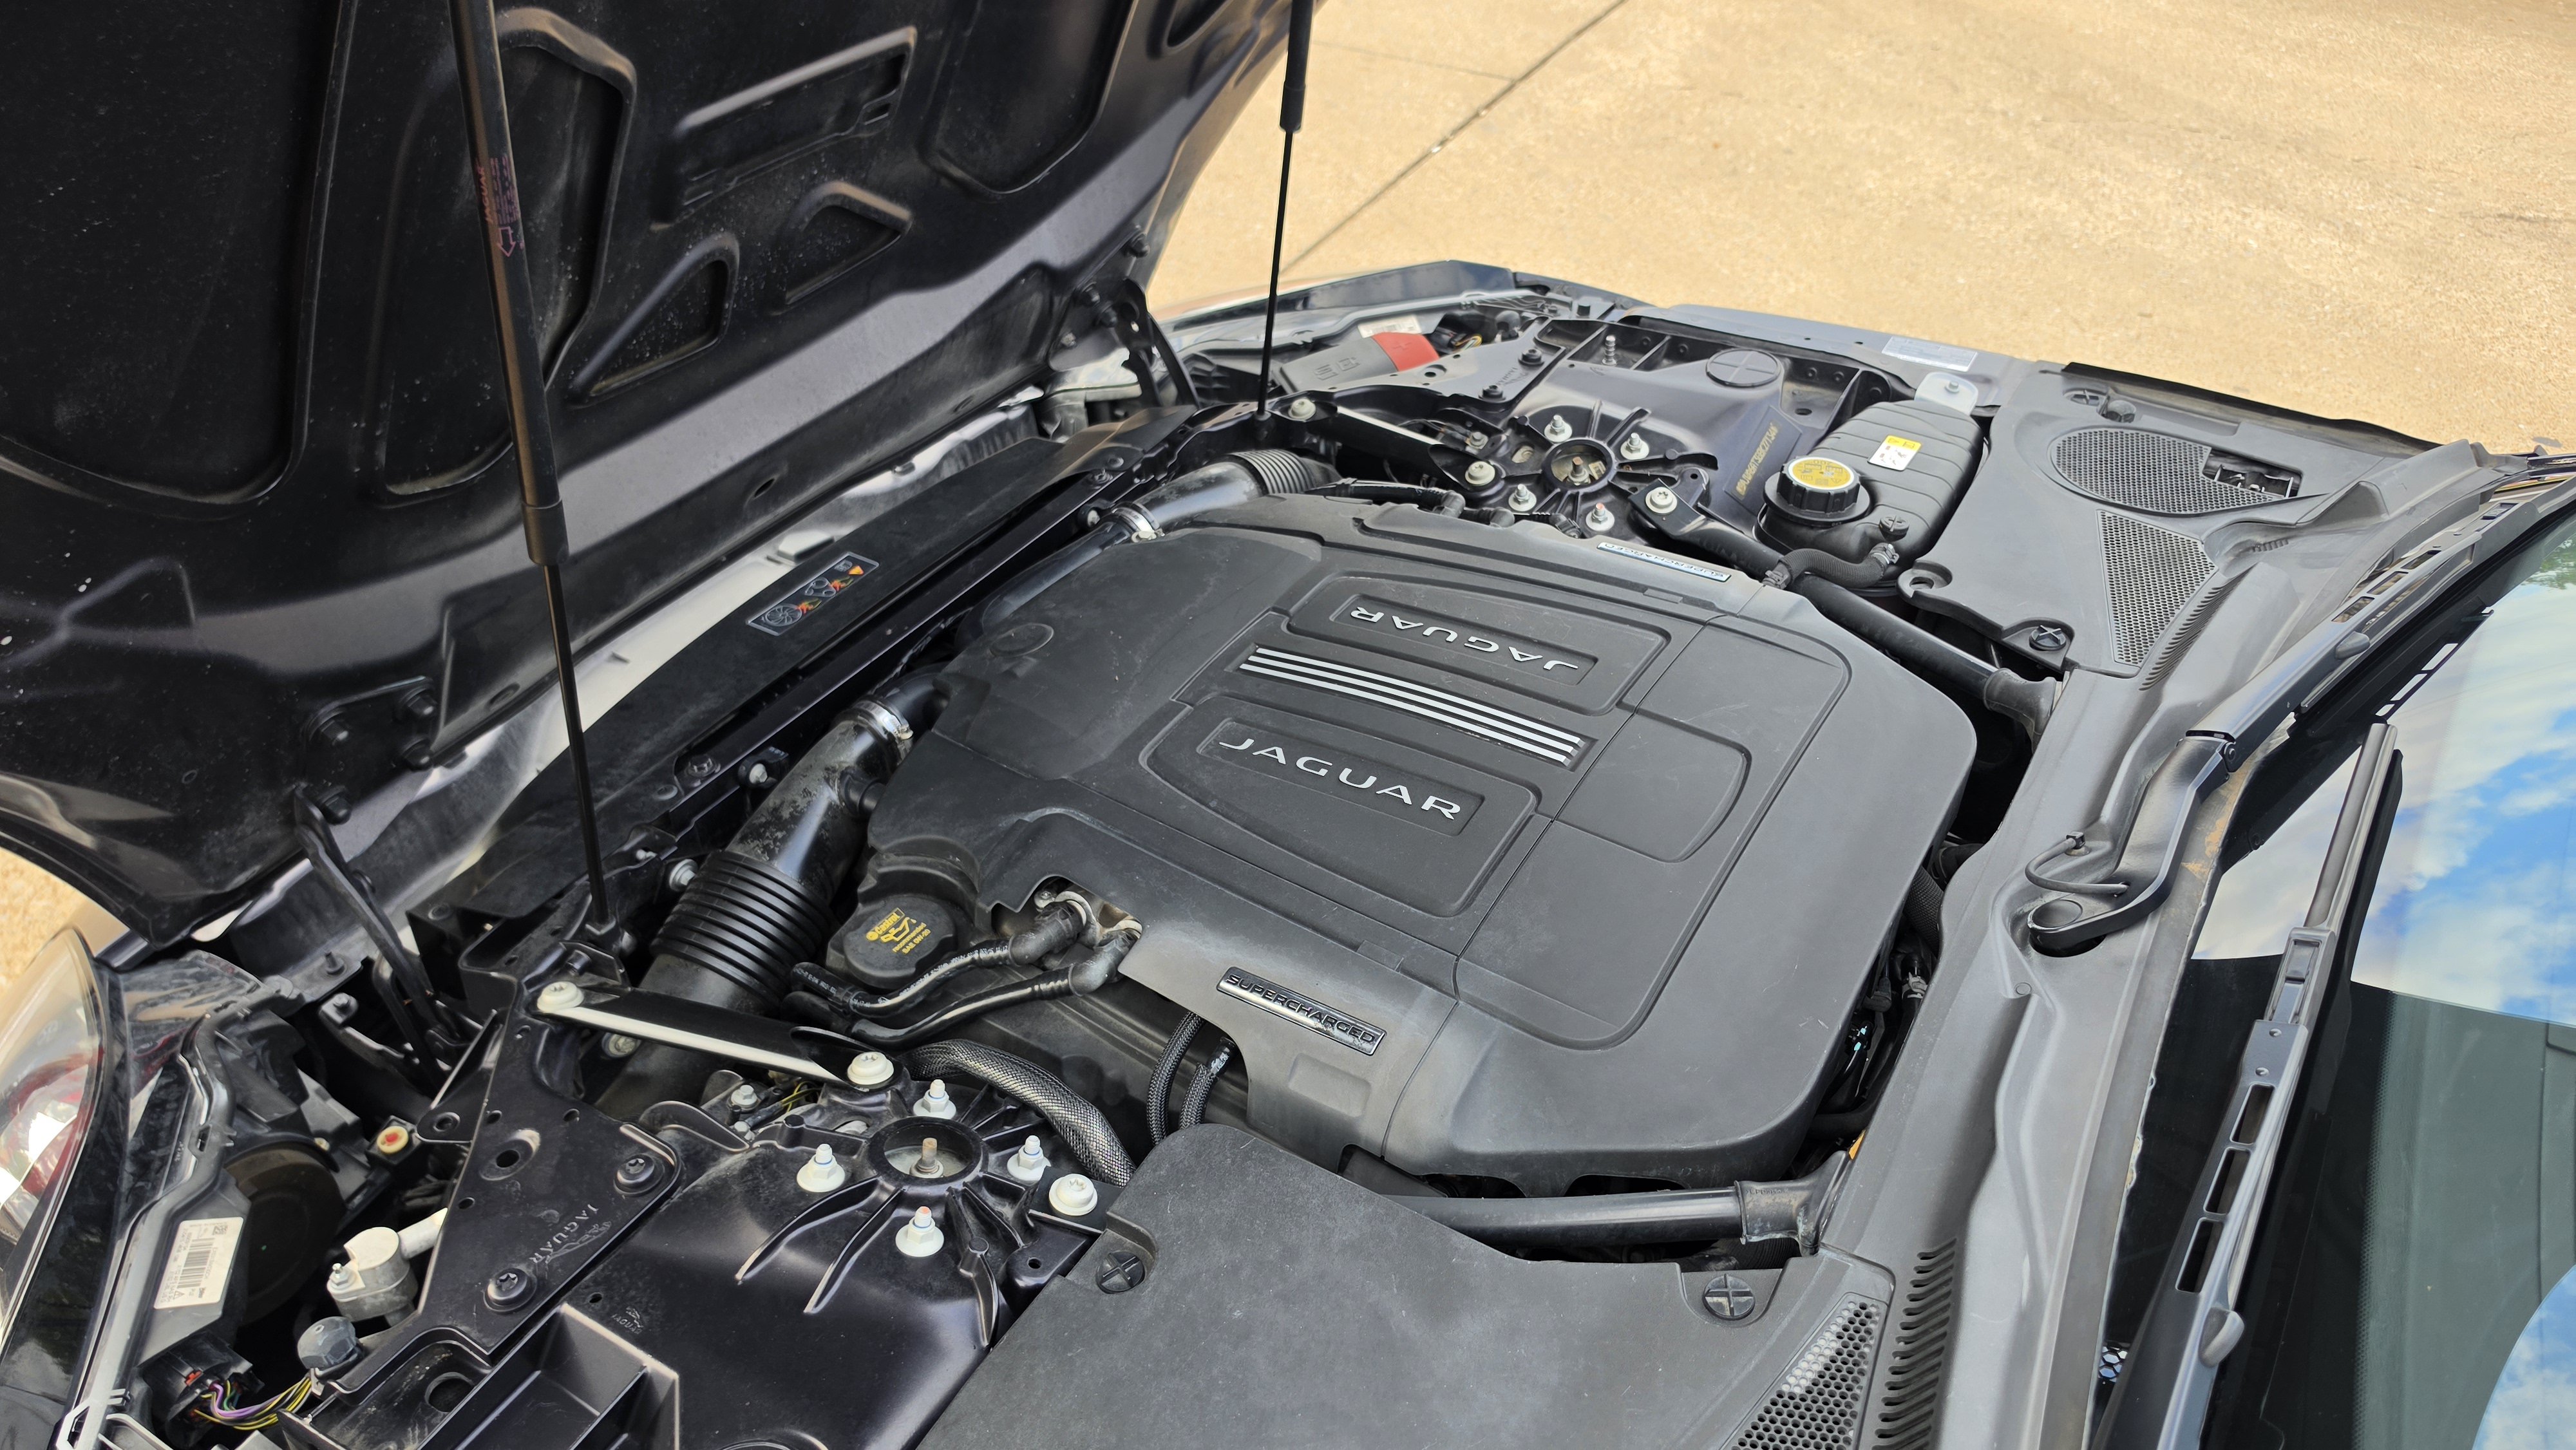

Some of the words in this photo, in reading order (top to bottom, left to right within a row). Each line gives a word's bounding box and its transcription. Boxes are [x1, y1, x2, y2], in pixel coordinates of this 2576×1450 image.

[1604, 543, 1725, 578] SUPERCHARGED
[1350, 606, 1579, 671] JAGUAR
[1218, 738, 1461, 820] JAGUAR
[875, 912, 901, 936] Castrol
[892, 921, 927, 953] recommended
[902, 942, 916, 954] SAE
[1226, 974, 1376, 1044] SUPERCHARGED
[529, 1203, 600, 1264] JAGUAR
